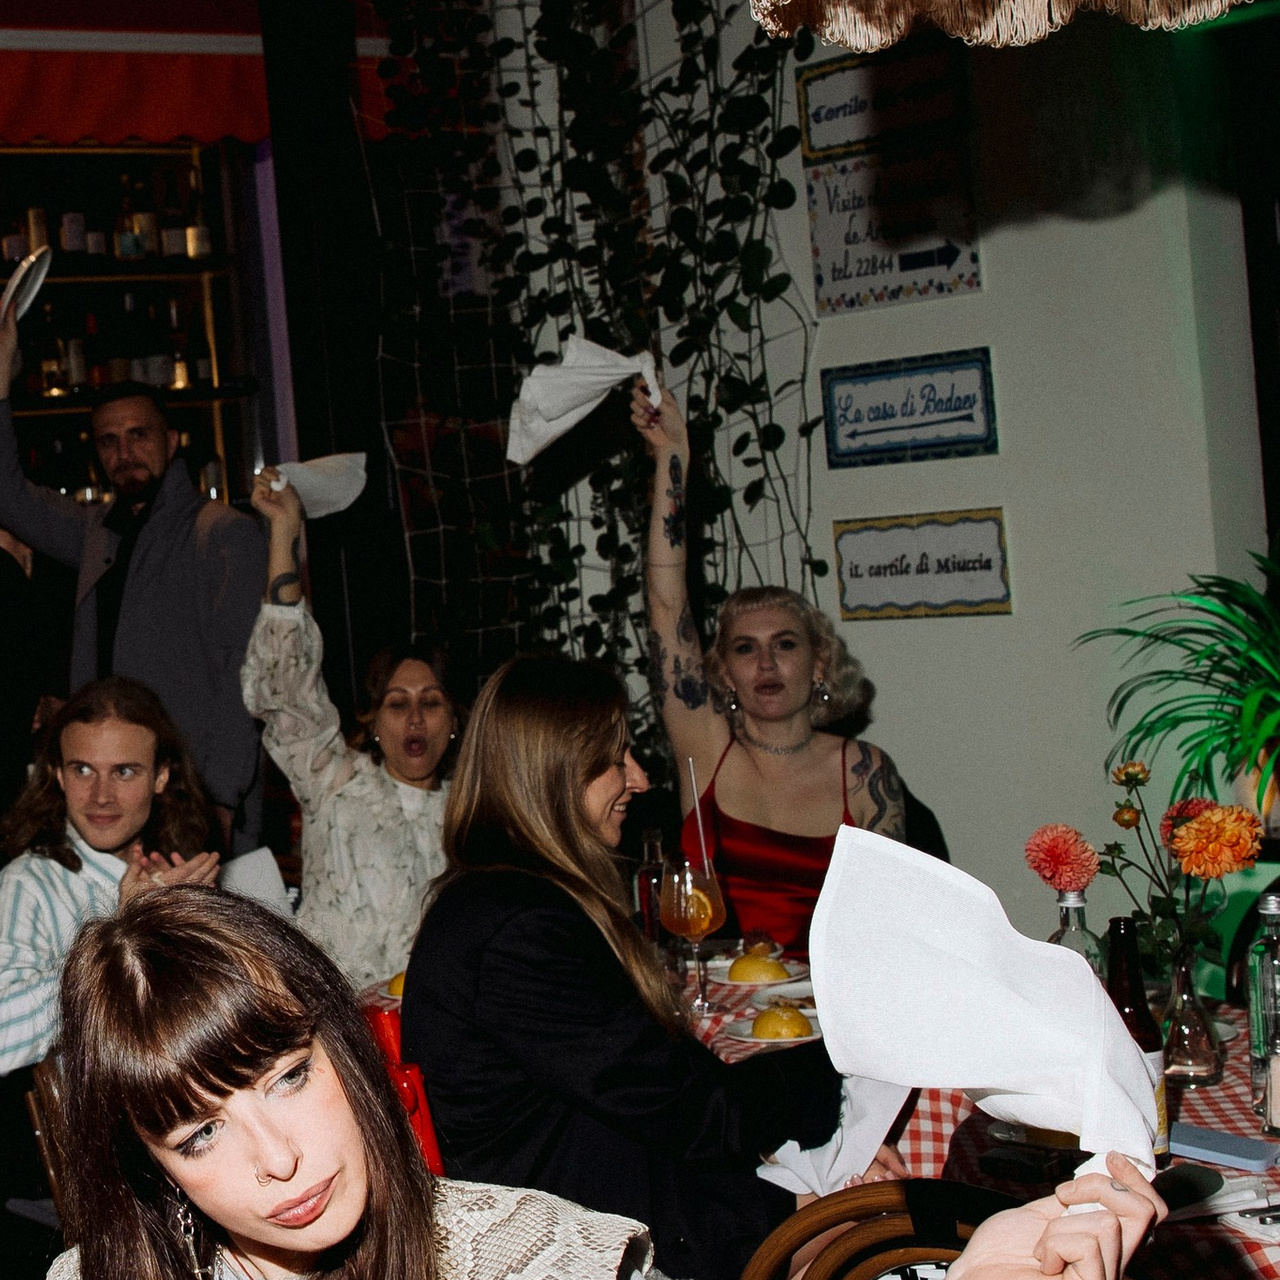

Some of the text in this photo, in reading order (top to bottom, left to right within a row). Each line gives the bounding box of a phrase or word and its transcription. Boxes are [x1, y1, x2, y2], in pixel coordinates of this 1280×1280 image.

[856, 253, 894, 277] 22844
[837, 393, 865, 426] La
[867, 401, 898, 423] casa
[900, 387, 917, 418] di
[915, 551, 930, 576] di
[934, 552, 993, 575] Miuccia
